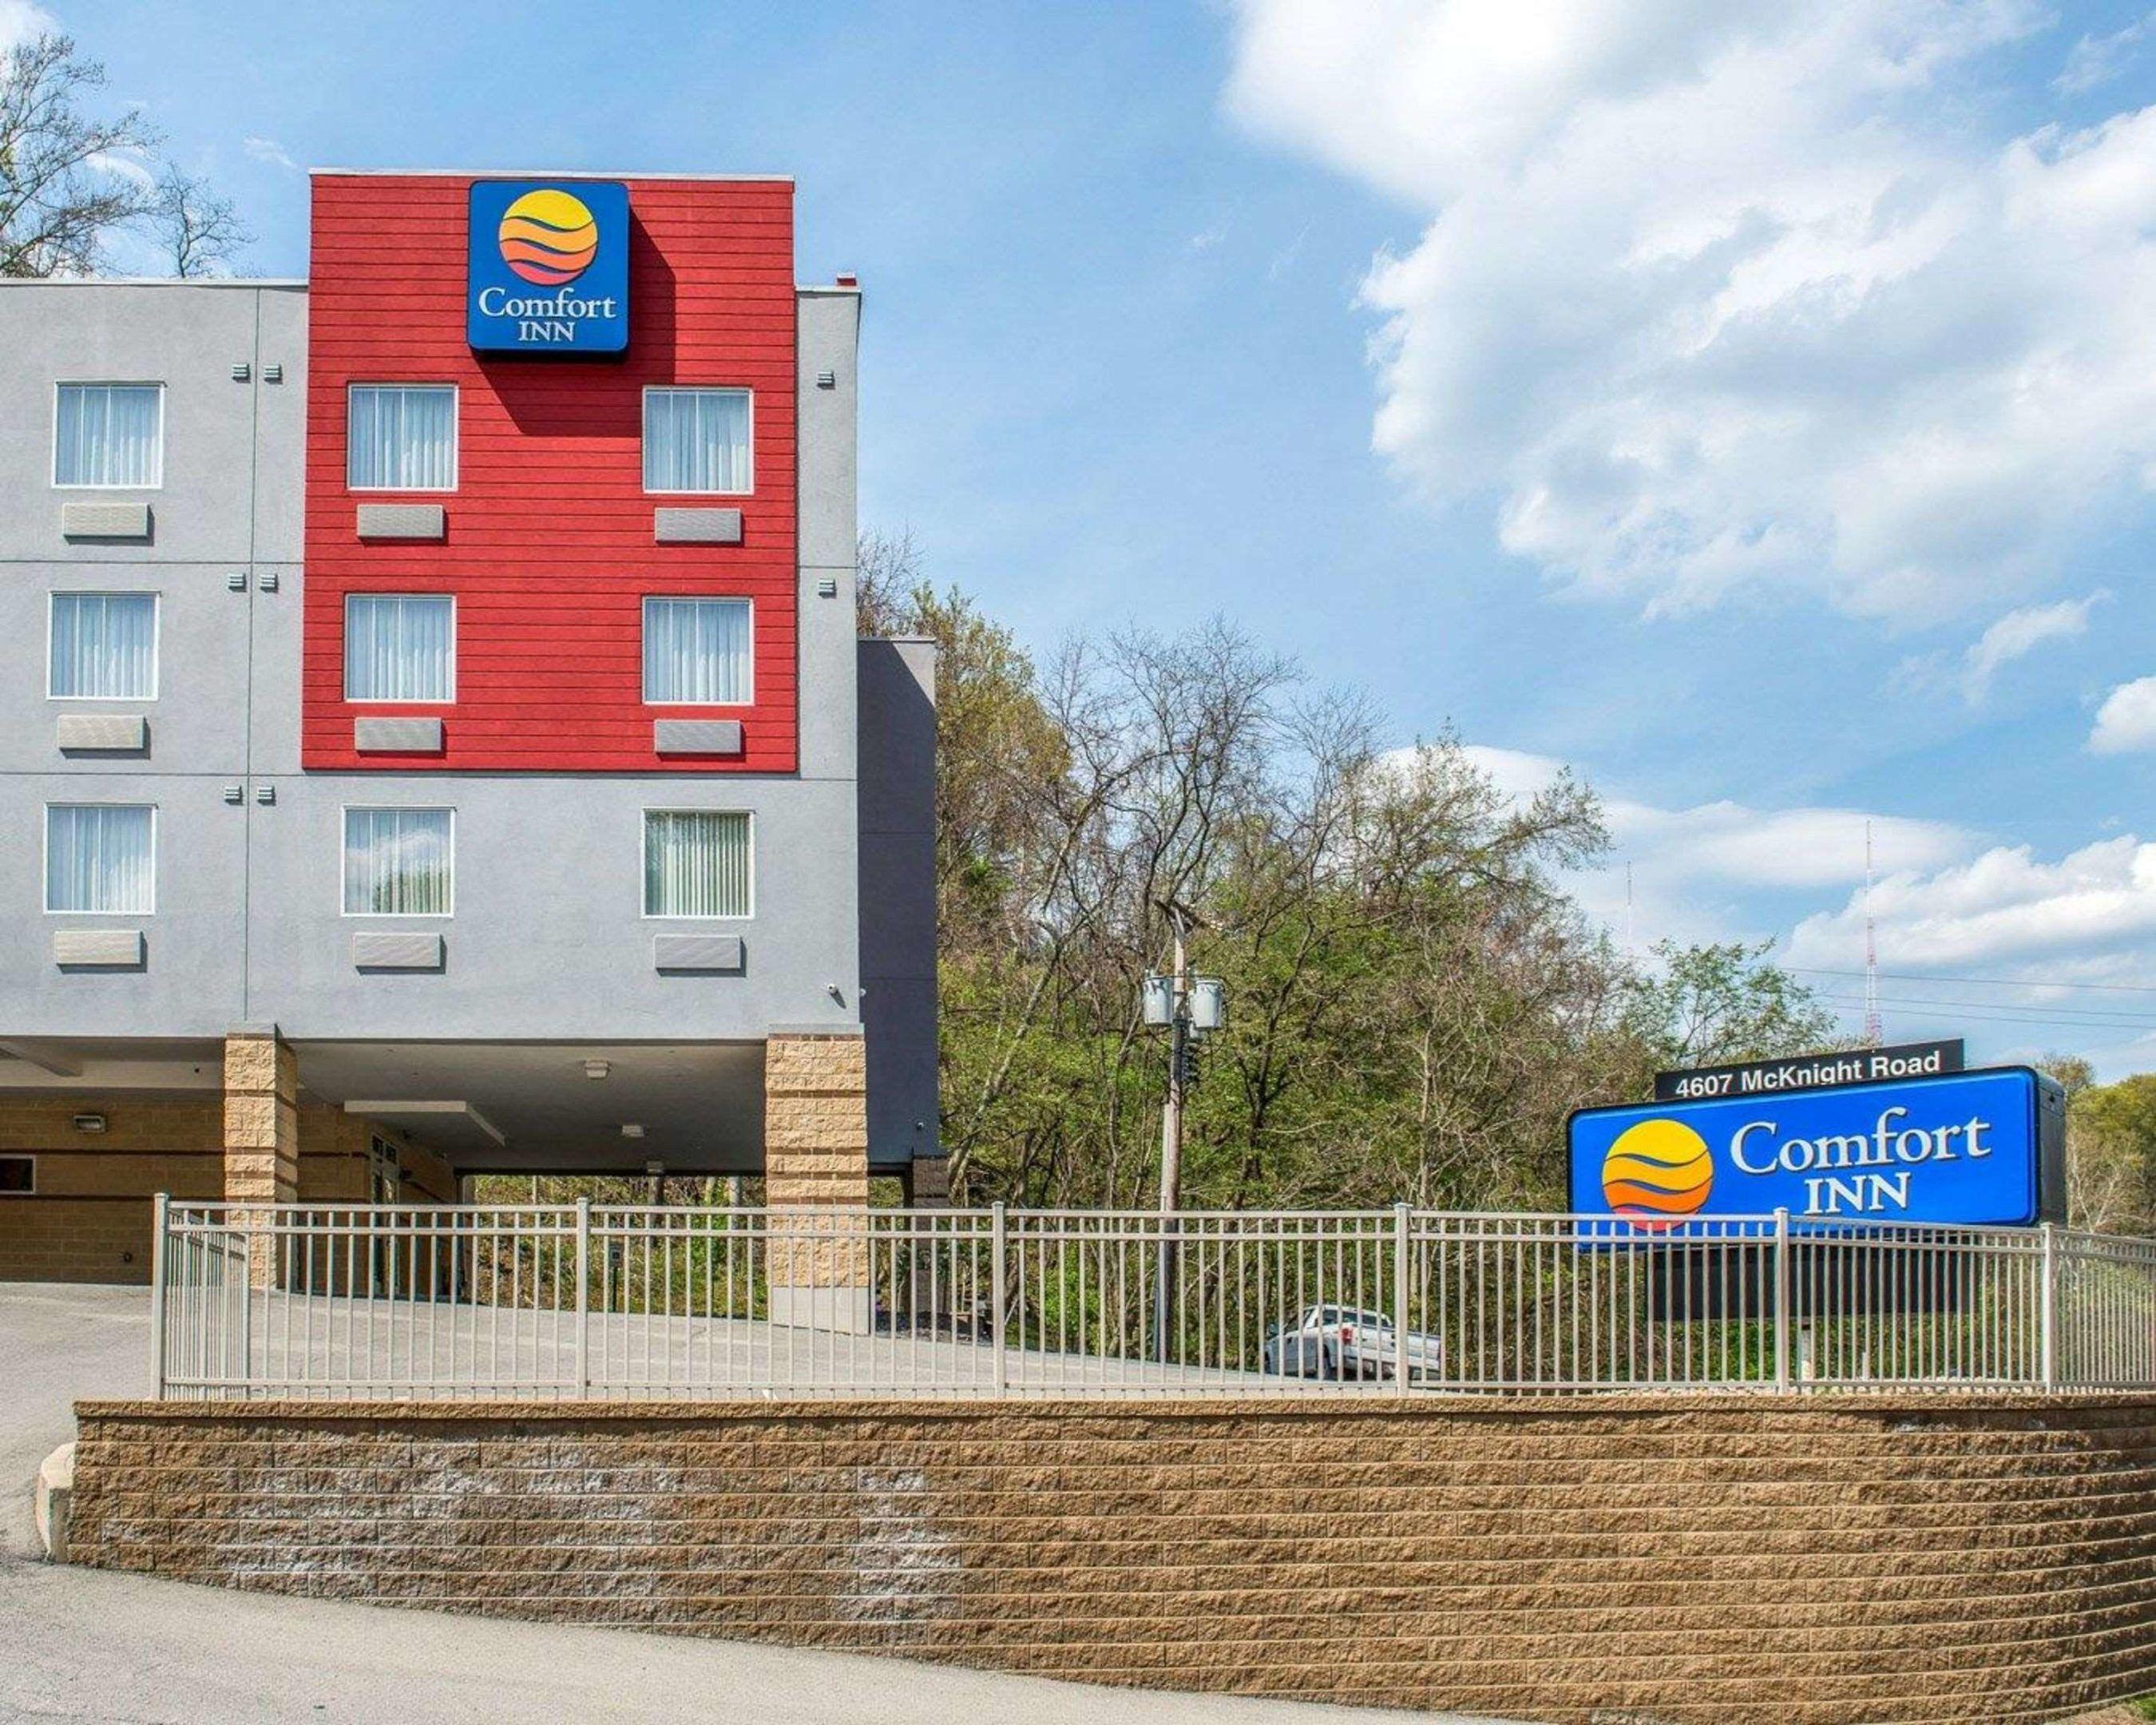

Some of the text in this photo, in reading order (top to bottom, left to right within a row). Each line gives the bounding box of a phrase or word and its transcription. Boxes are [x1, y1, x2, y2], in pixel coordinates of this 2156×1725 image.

[478, 287, 616, 319] Comfort
[518, 320, 576, 342] INN
[1675, 1050, 1940, 1098] 4607 McKnight Road
[1730, 1106, 1992, 1174] Comfort
[1804, 1172, 1911, 1215] INN
